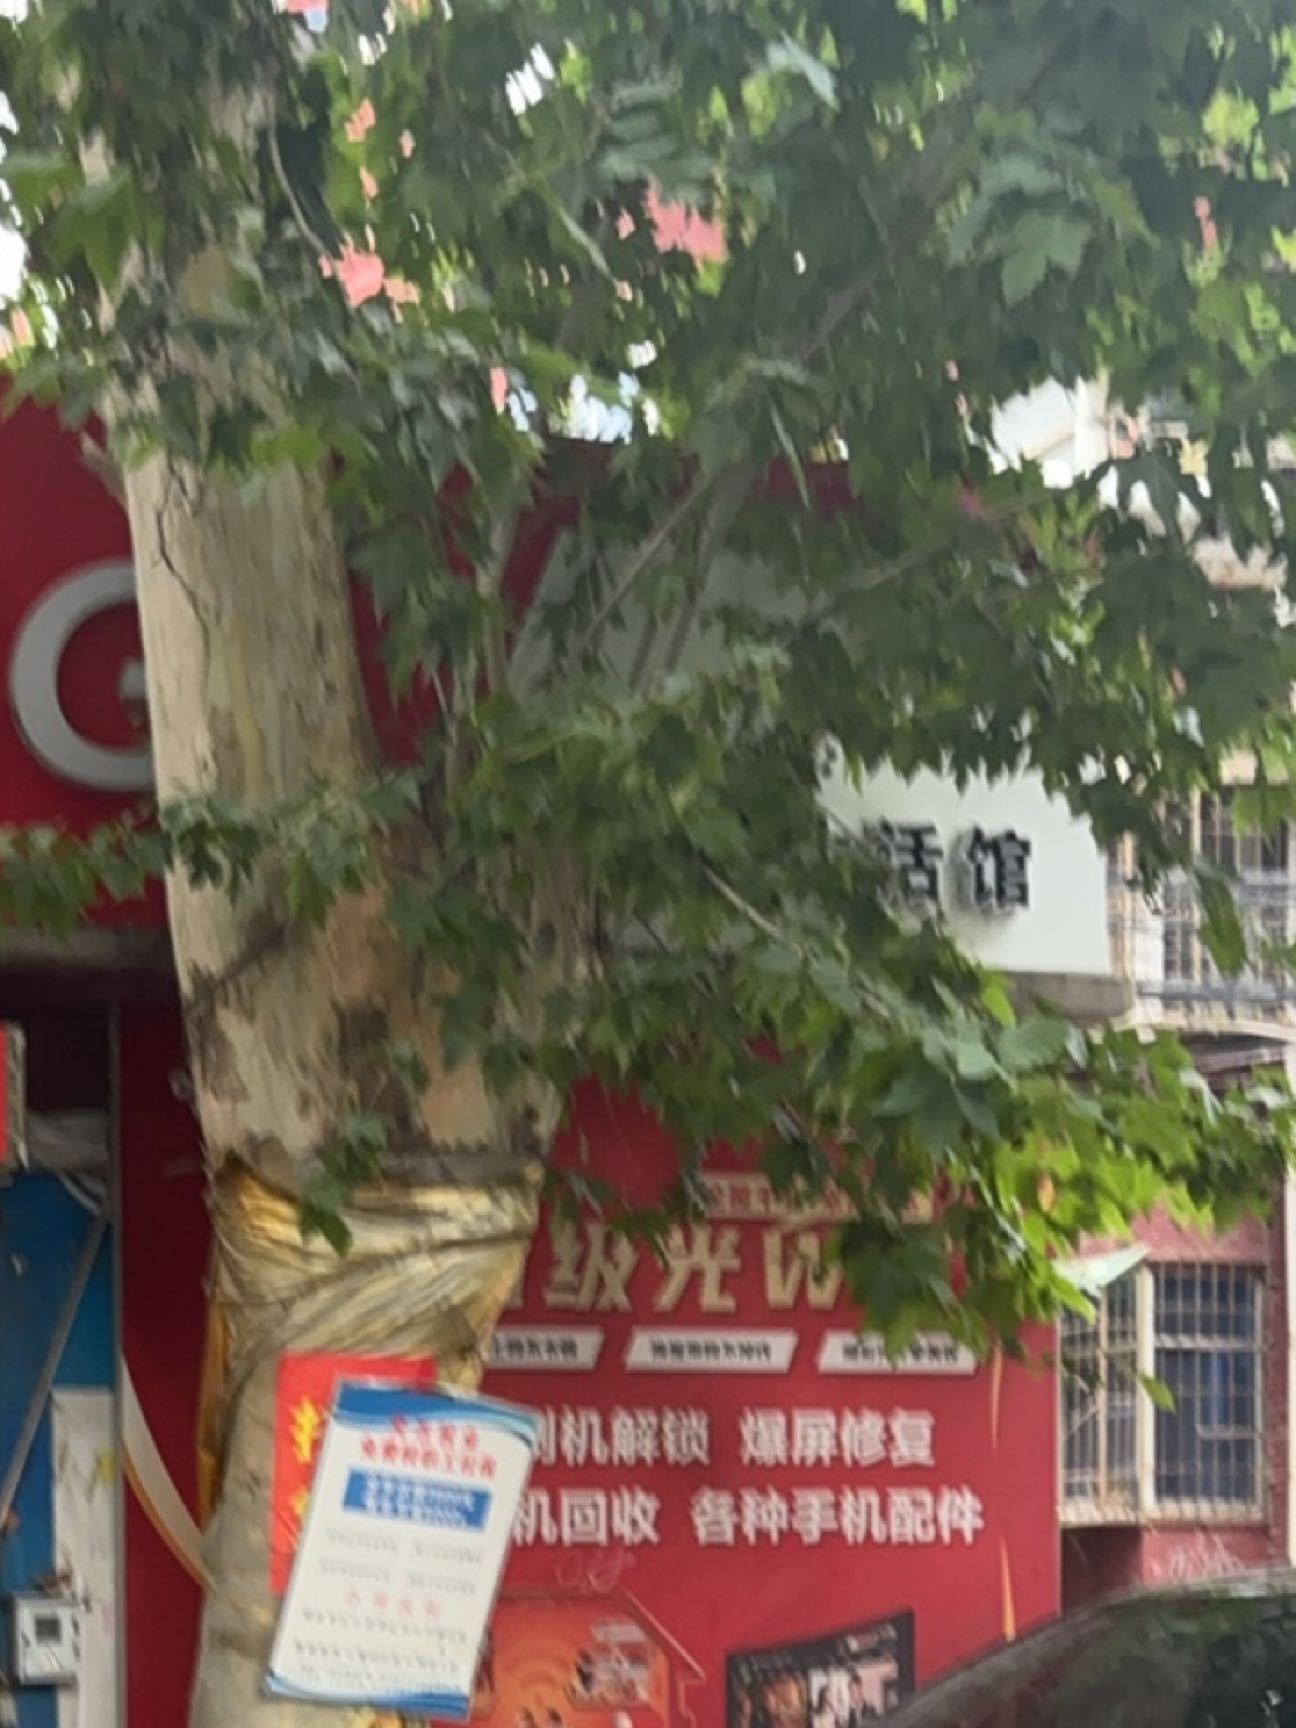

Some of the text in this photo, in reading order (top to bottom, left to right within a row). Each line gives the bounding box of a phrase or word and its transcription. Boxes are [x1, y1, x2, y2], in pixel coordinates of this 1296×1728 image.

[738, 1406, 936, 1468] 爆屏修复
[690, 1484, 984, 1548] 各种手机配件
